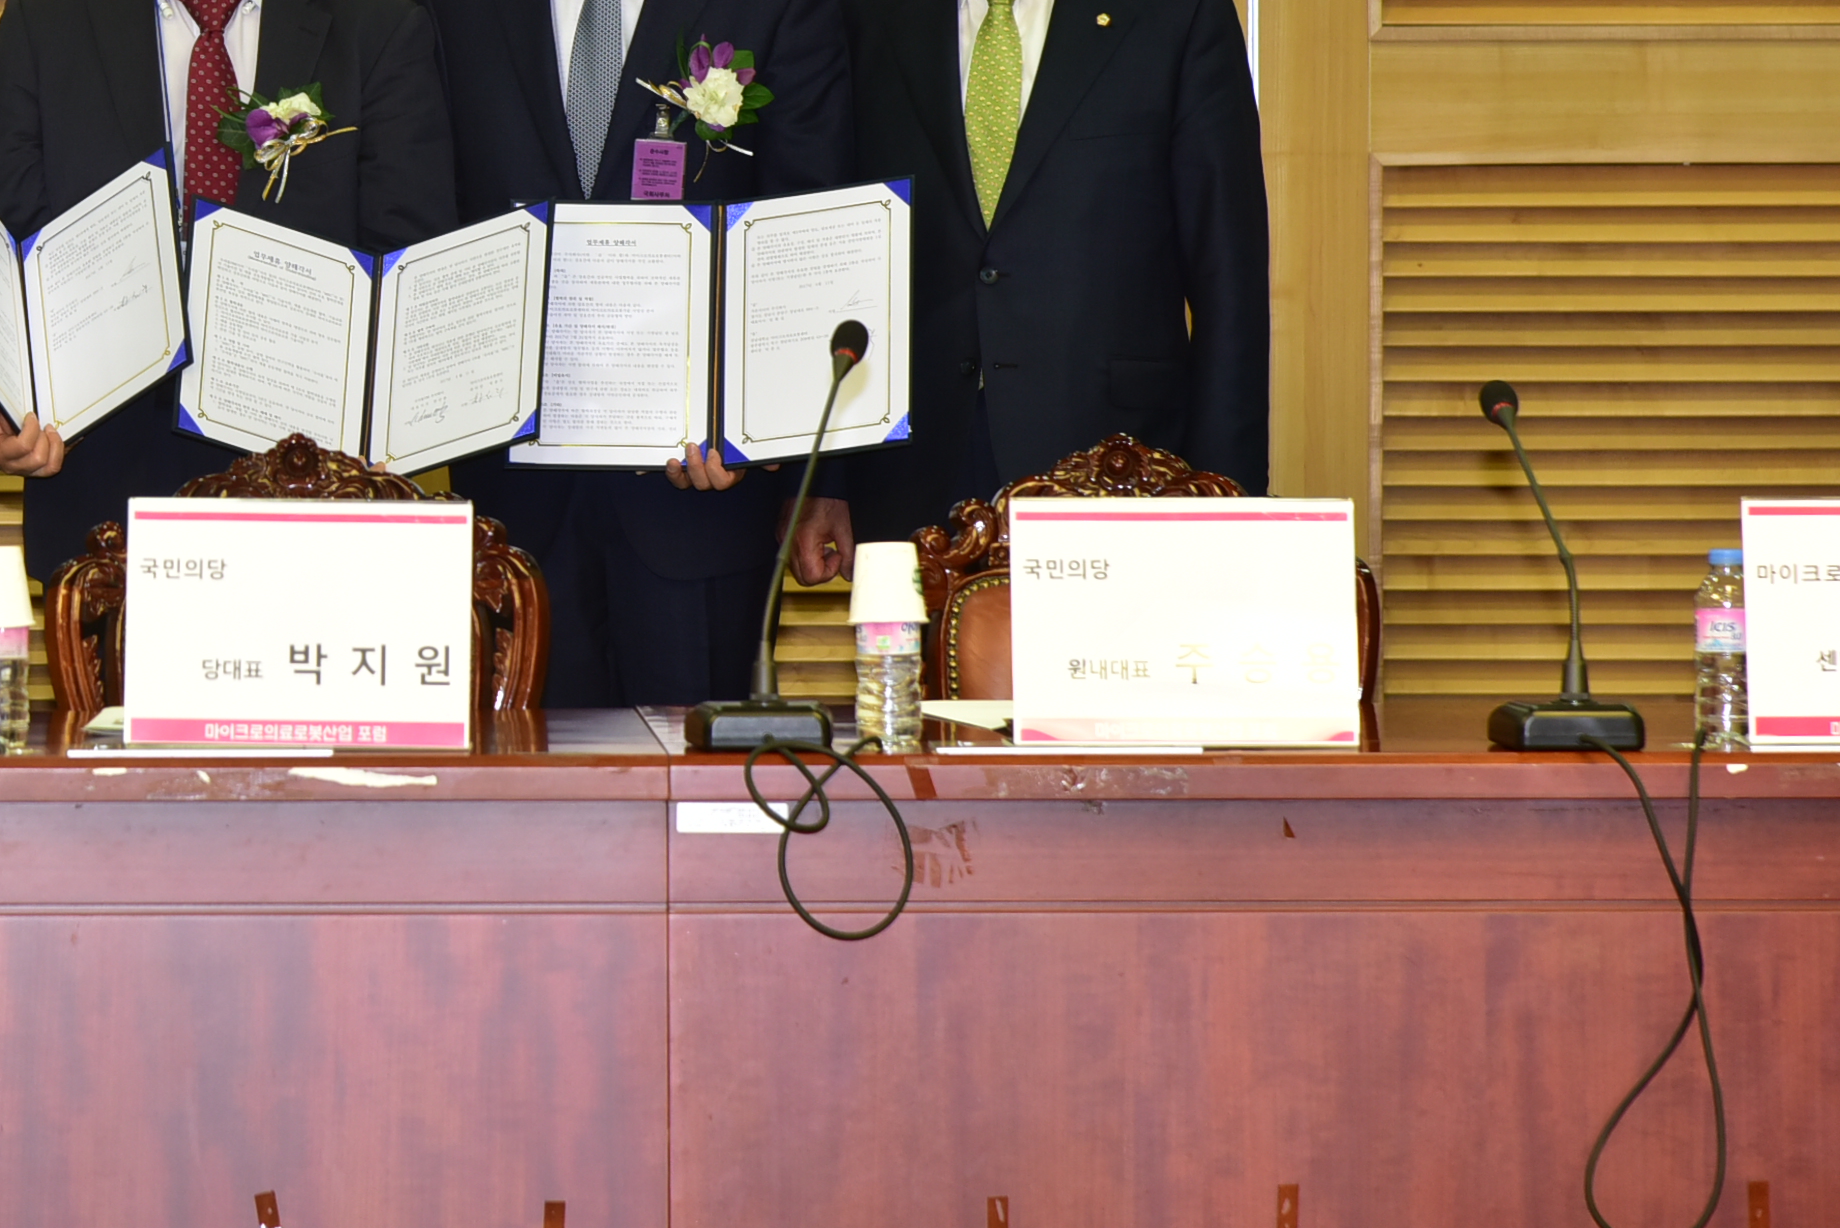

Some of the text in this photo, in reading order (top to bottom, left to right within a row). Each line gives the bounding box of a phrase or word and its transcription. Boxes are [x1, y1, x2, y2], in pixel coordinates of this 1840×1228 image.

[140, 558, 227, 580] 국민의당
[1023, 558, 1110, 580] 국민의당
[201, 658, 262, 681] 당대표
[1067, 658, 1151, 681] 원내대표
[205, 723, 388, 743] 마이크로의료로봇산업 포럼
